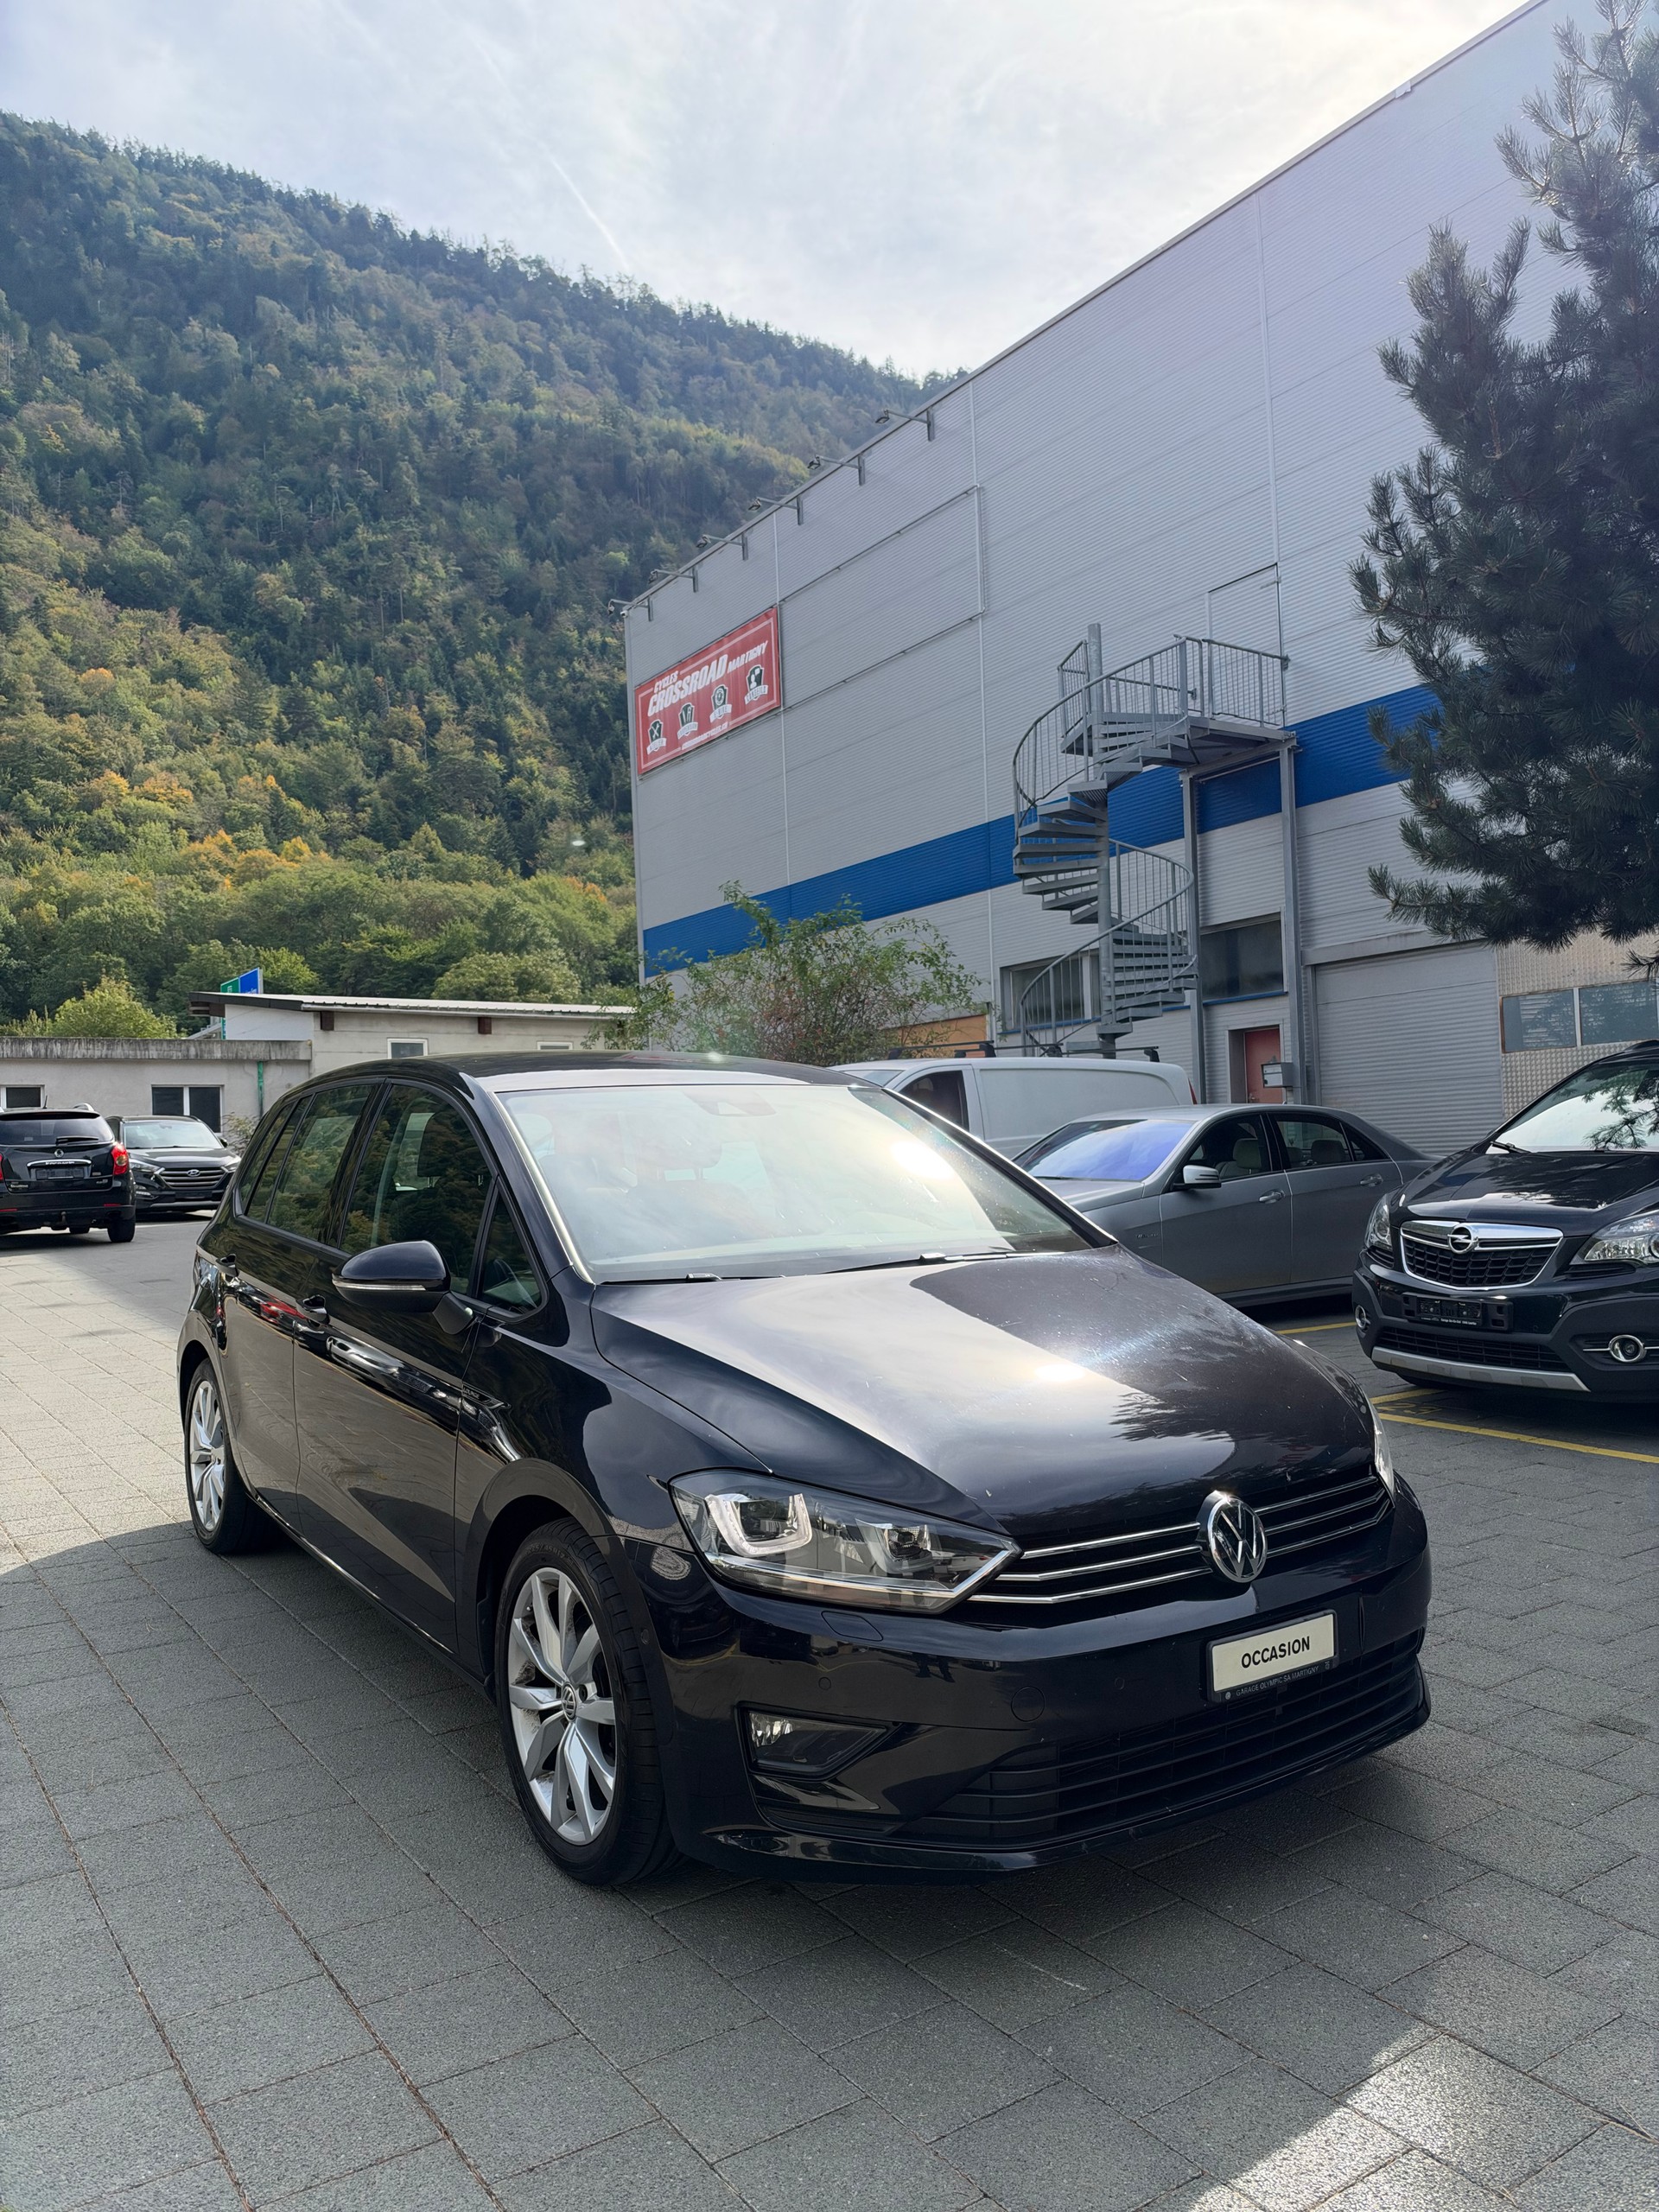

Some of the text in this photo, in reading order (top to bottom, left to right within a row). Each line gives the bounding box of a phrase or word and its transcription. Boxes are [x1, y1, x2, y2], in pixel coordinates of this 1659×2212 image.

[648, 640, 768, 716] CROSSROAD MARTIGNY
[653, 671, 679, 693] CYCLES
[1241, 1636, 1311, 1669] OCCASION
[1236, 1684, 1259, 1696] GARAGE
[1260, 1676, 1283, 1689] OLYMPIC
[1292, 1666, 1319, 1680] MARTIGNY
